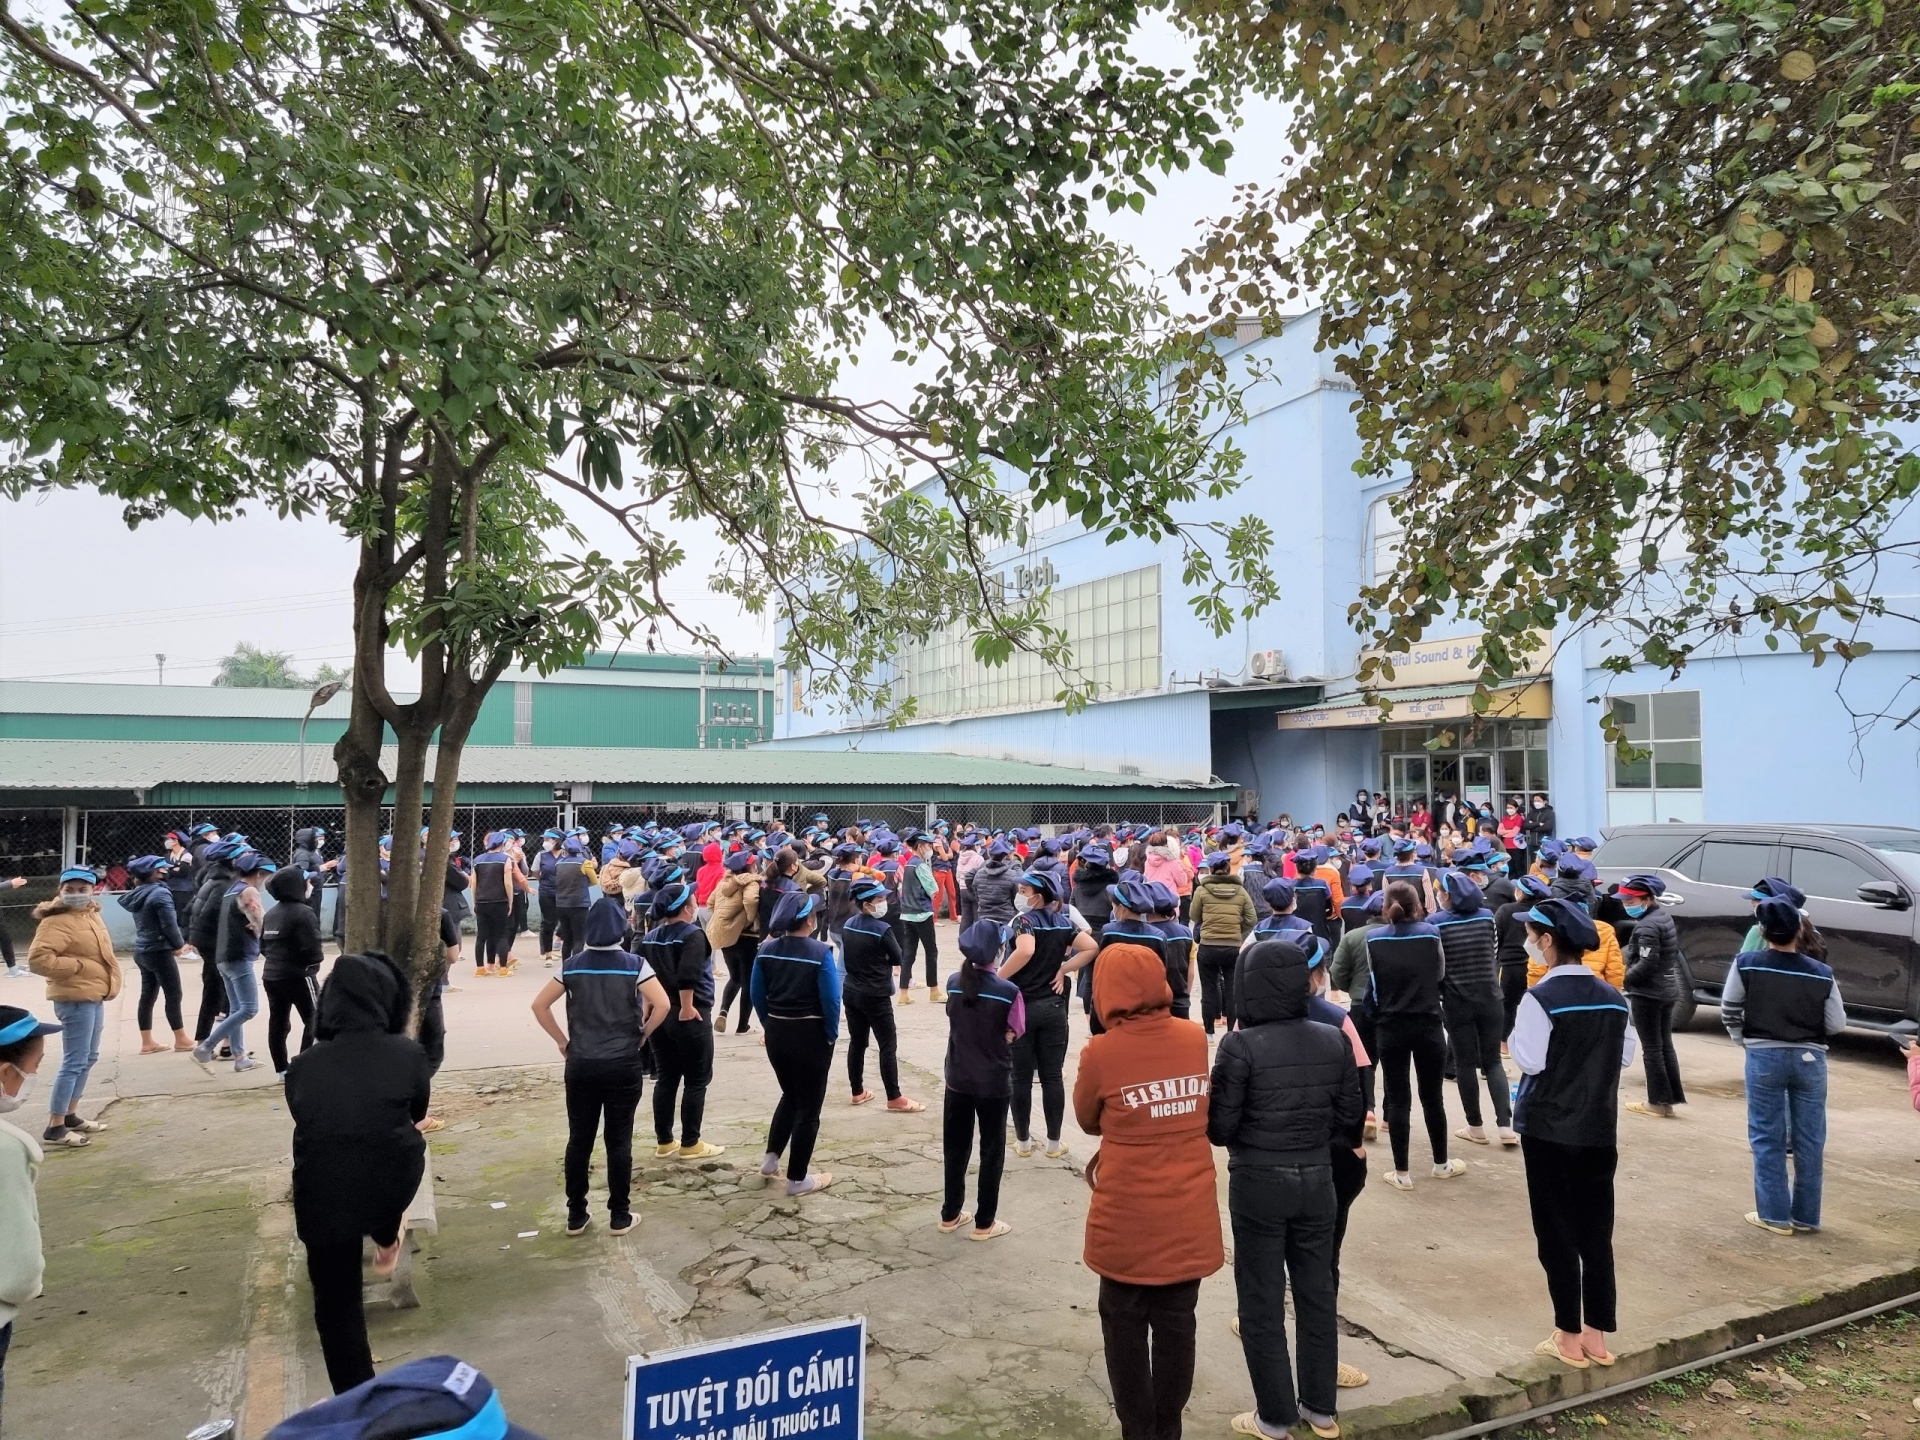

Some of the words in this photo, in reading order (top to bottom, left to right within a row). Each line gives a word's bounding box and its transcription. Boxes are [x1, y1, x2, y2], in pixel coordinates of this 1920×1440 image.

[1414, 647, 1449, 665] Sound
[1452, 646, 1464, 660] &
[1150, 1098, 1198, 1119] NICEDAY
[646, 1376, 729, 1430] TUYỆT
[735, 1359, 779, 1411] ĐỐI
[787, 1349, 855, 1400] CẤM!
[771, 1401, 820, 1438] THUỐC
